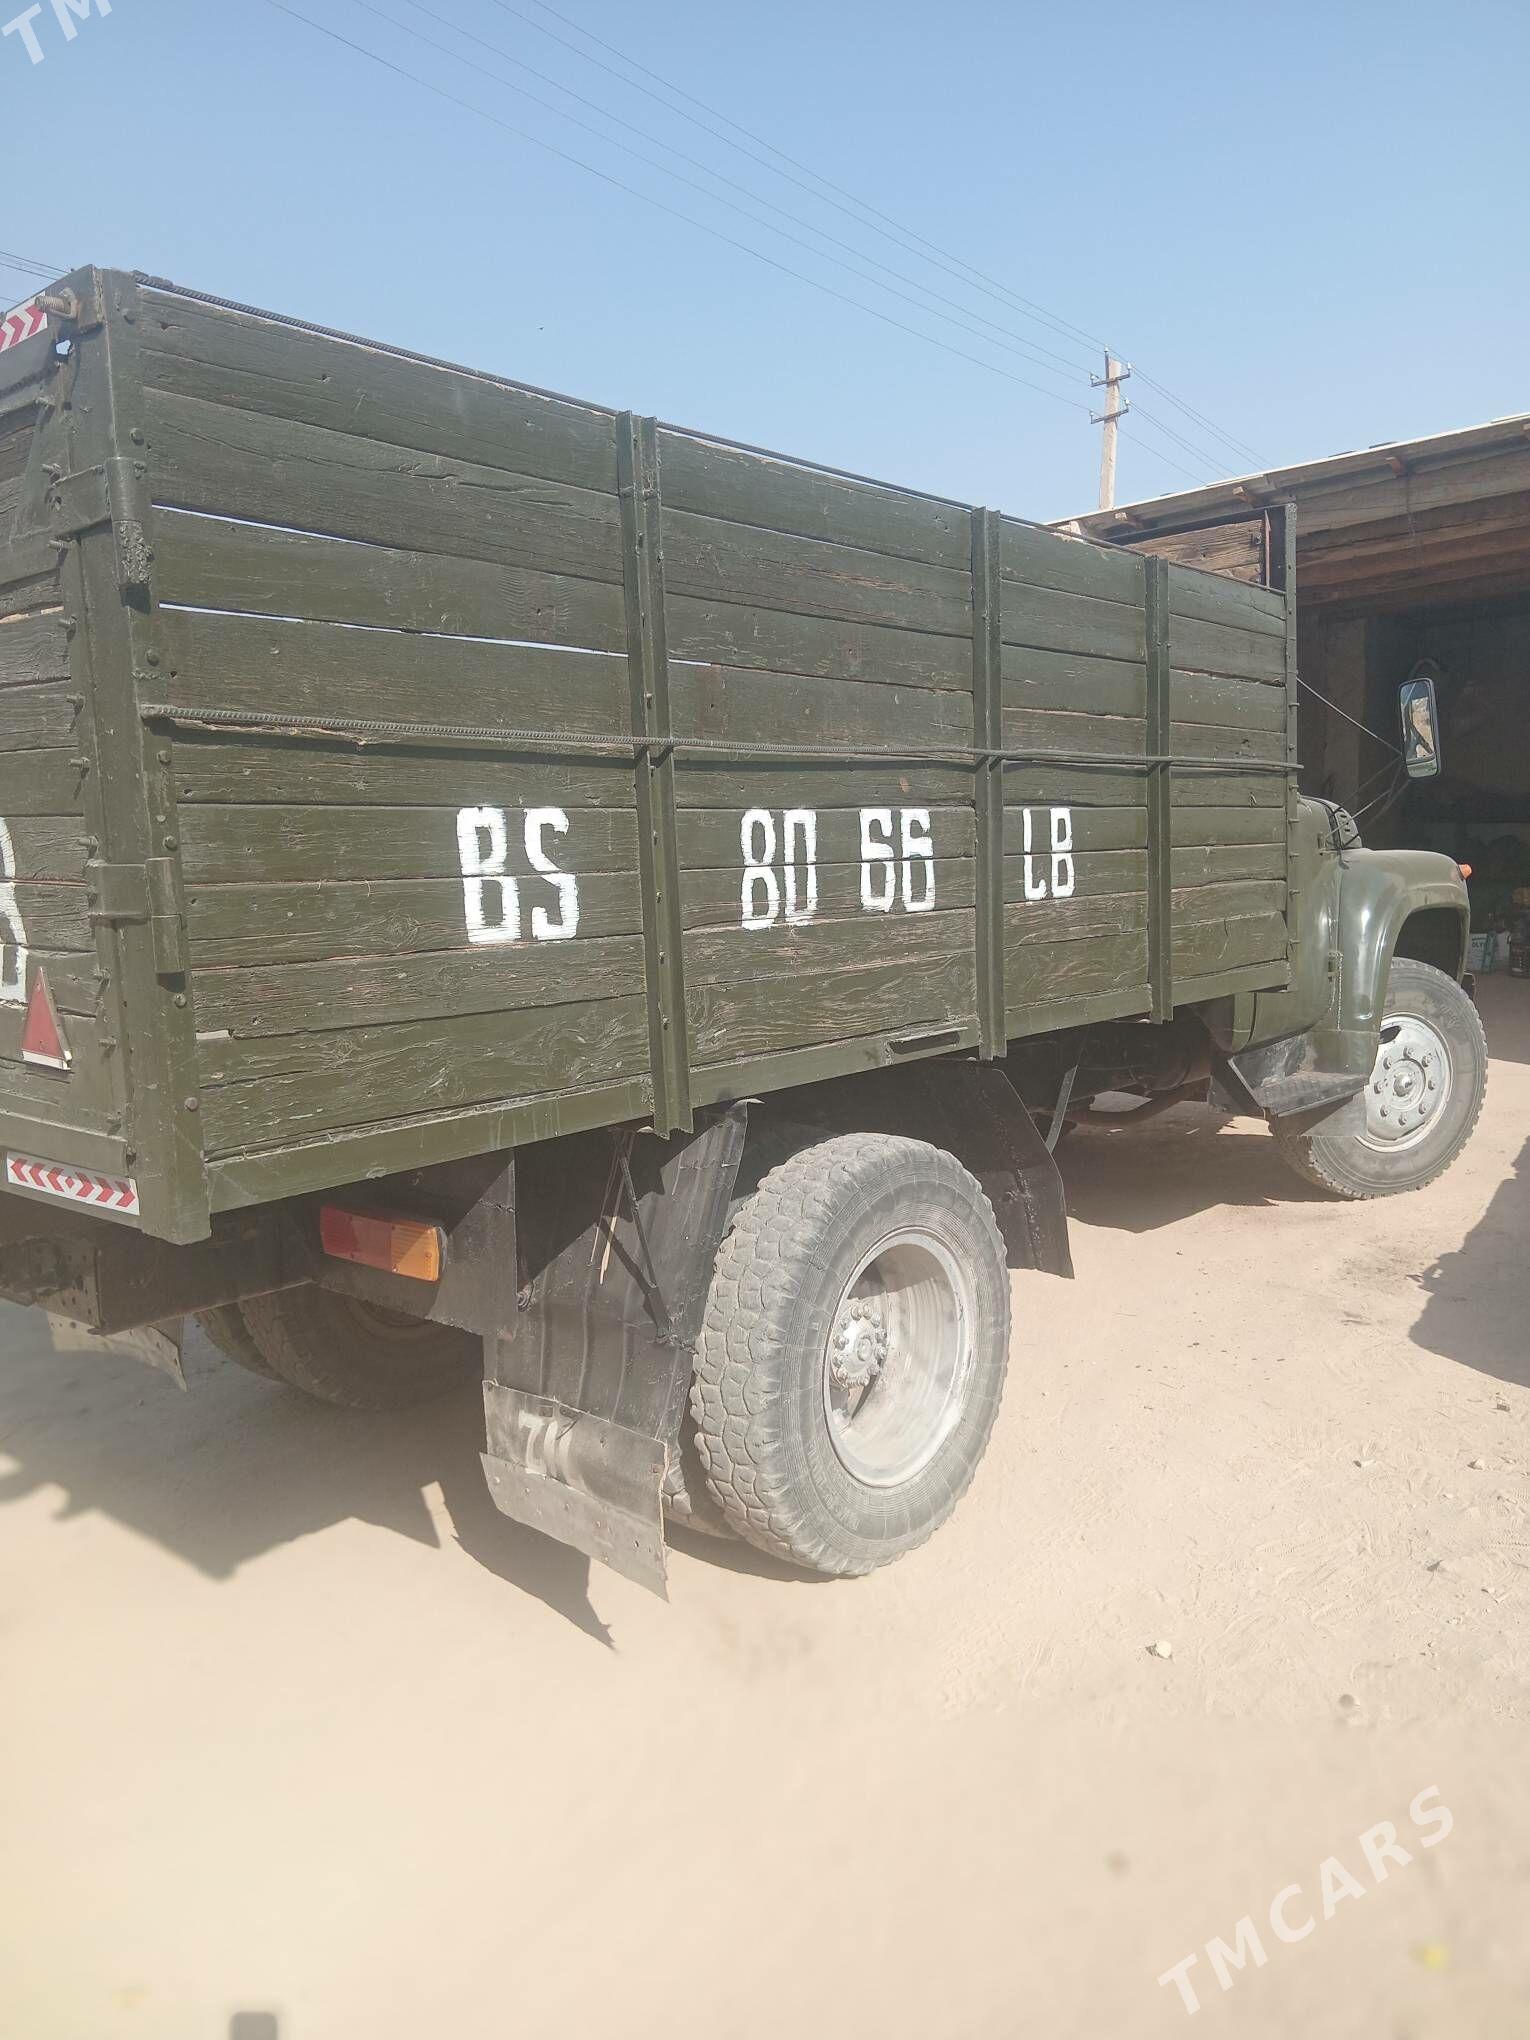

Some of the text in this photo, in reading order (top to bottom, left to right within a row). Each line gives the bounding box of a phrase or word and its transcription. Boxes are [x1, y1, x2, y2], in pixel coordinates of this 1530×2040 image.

[457, 807, 1075, 944] BS 80 66 LB
